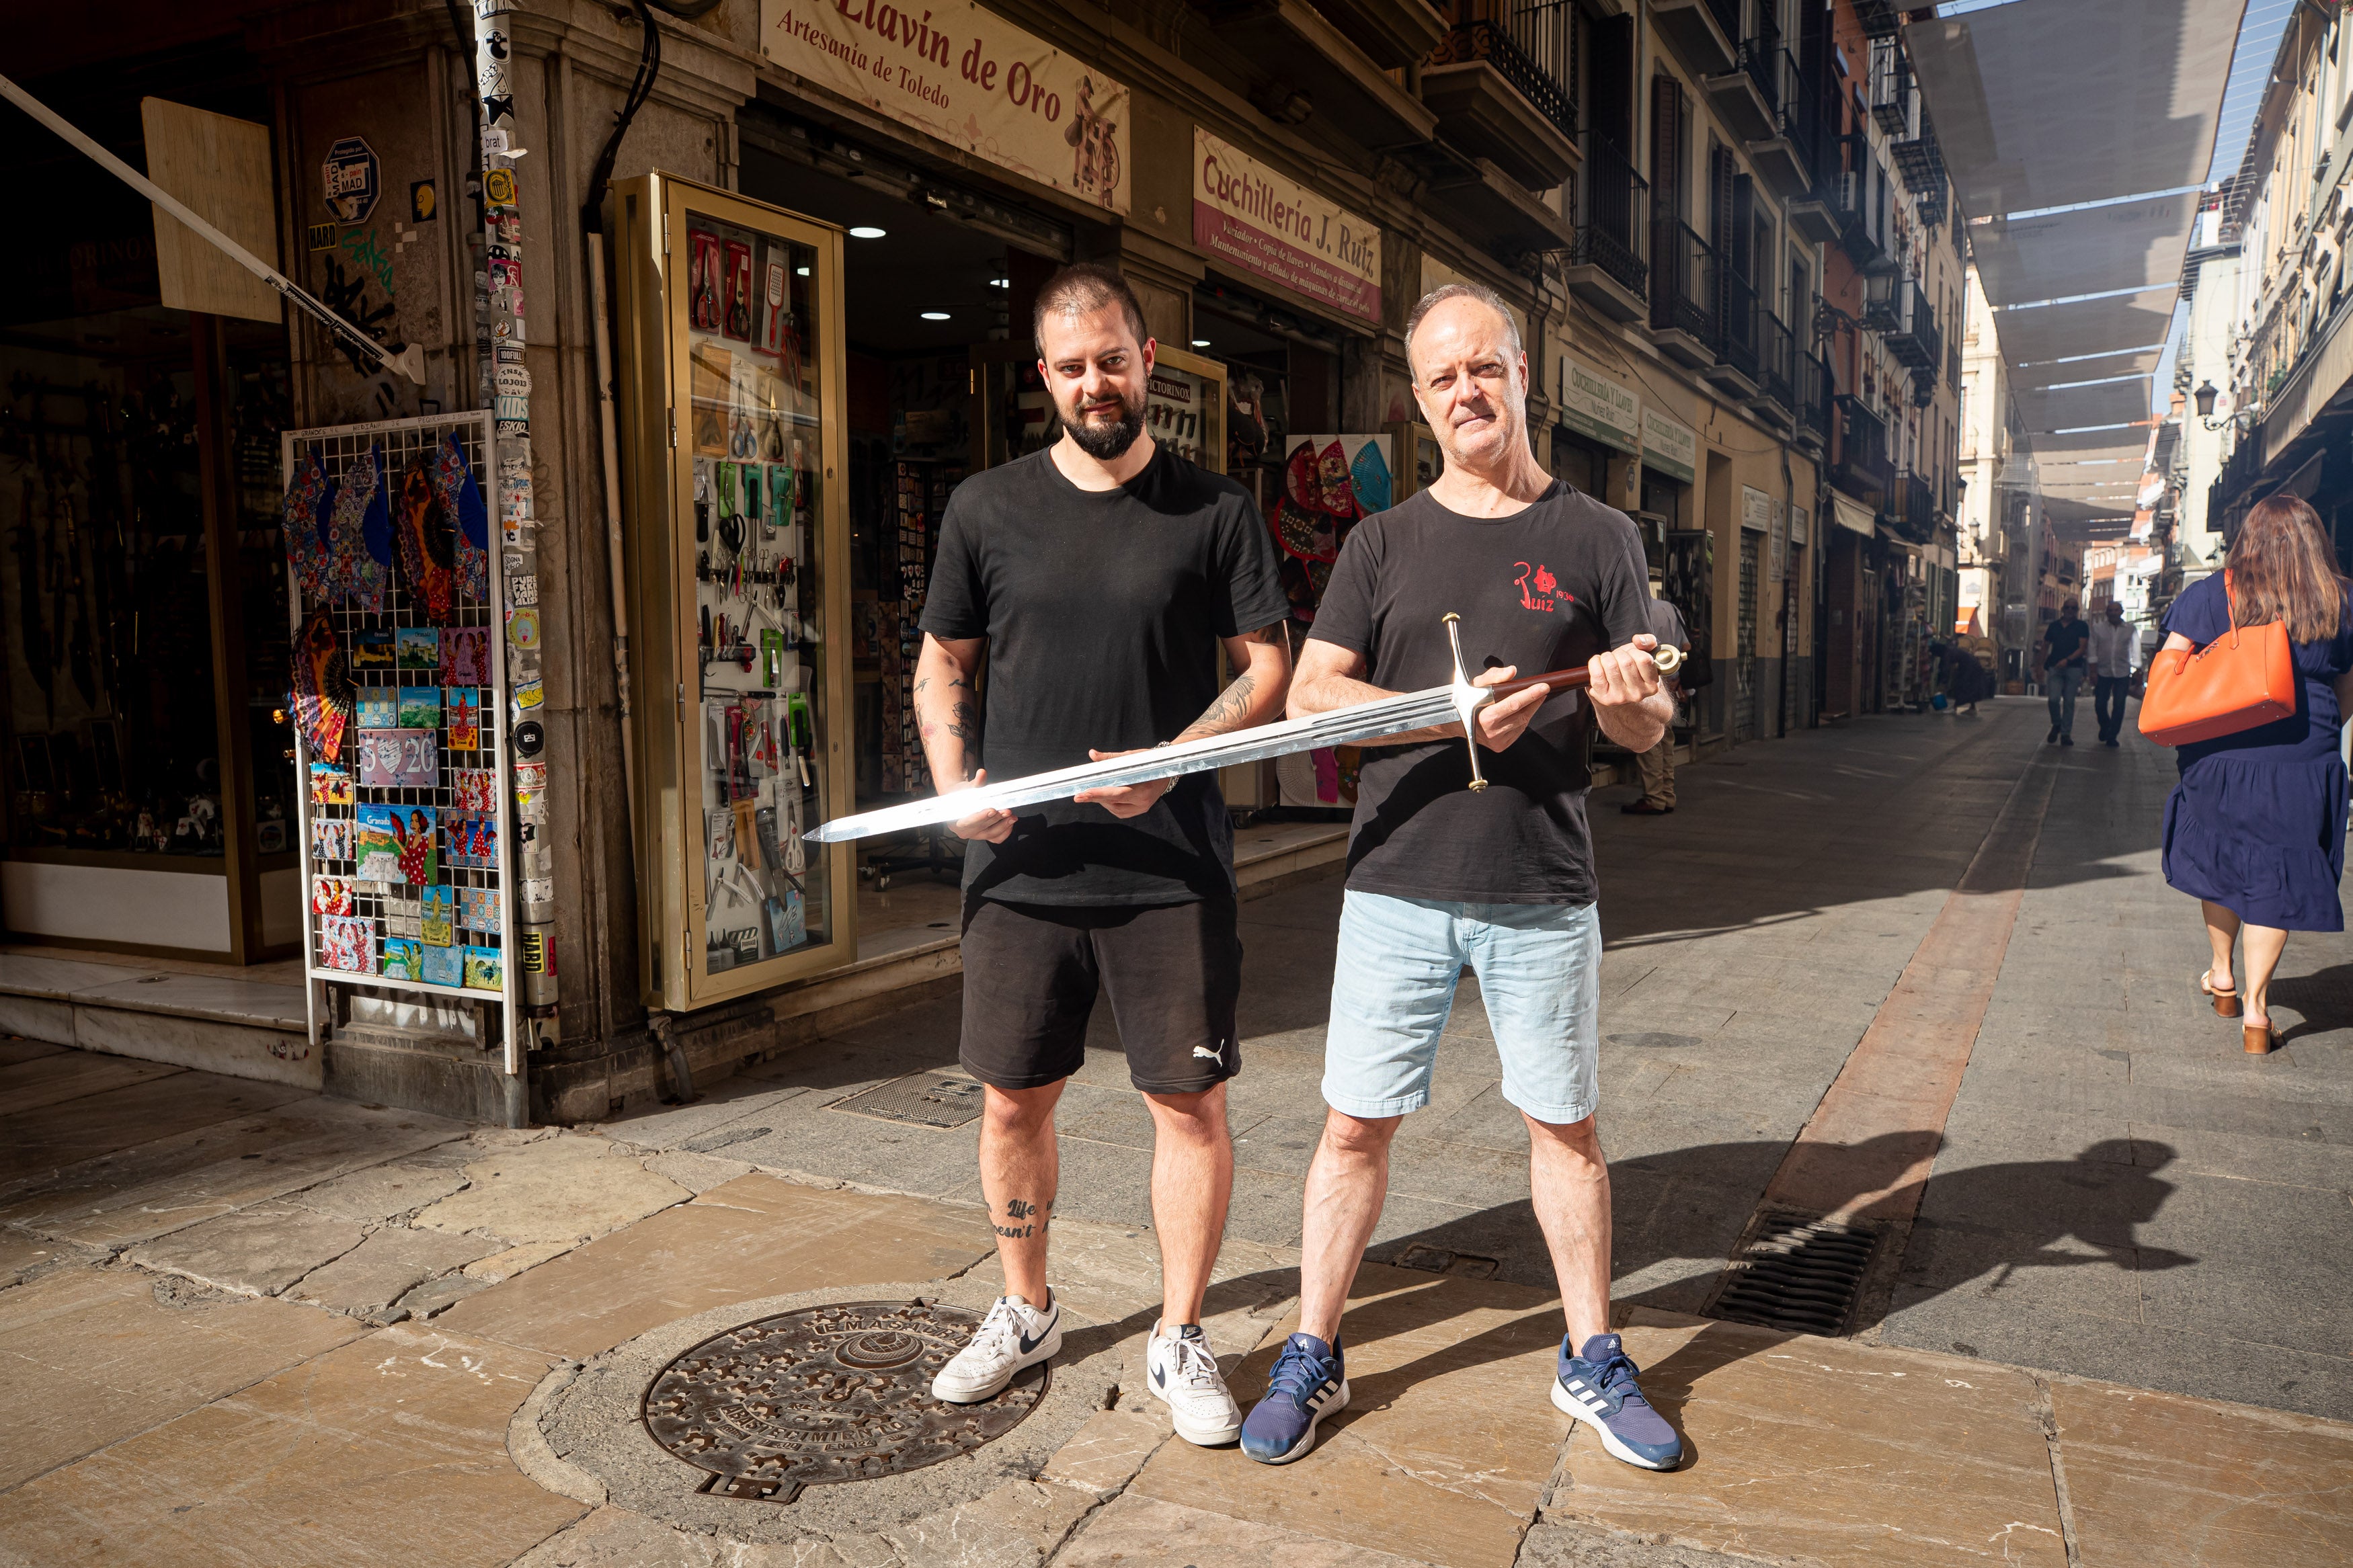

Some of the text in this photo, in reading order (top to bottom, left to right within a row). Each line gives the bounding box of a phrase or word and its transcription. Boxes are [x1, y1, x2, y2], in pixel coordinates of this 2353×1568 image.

[776, 9, 949, 109] Artesanía de Toledo
[836, 0, 1061, 122] Llavín de Oro
[485, 137, 501, 149] brat
[331, 165, 340, 196] MAD
[342, 177, 363, 192] MAD
[349, 169, 362, 178] pain
[1203, 155, 1312, 243] Cuchillería
[1316, 214, 1331, 255] J.
[309, 224, 336, 250] HARD
[1209, 233, 1263, 267] Mantenimiento
[1262, 261, 1268, 272] y
[1267, 260, 1290, 280] afilado
[1289, 270, 1299, 284] de
[1298, 275, 1328, 297] máquinas
[1328, 286, 1337, 300] de
[1258, 237, 1277, 256] Copia
[1278, 247, 1287, 261] de
[1286, 251, 1305, 269] llaves
[1310, 261, 1333, 282] Mandos
[1333, 275, 1338, 284] a
[500, 350, 522, 361] 100FULL
[1148, 379, 1190, 401] ICTORINOX
[367, 815, 391, 827] Granada
[522, 933, 543, 973] HARD
[1007, 1199, 1037, 1221] Life
[993, 1223, 1037, 1239] oesn't
[723, 1405, 908, 1443] ABASTECIMIENTO
[852, 1440, 876, 1448] 124
